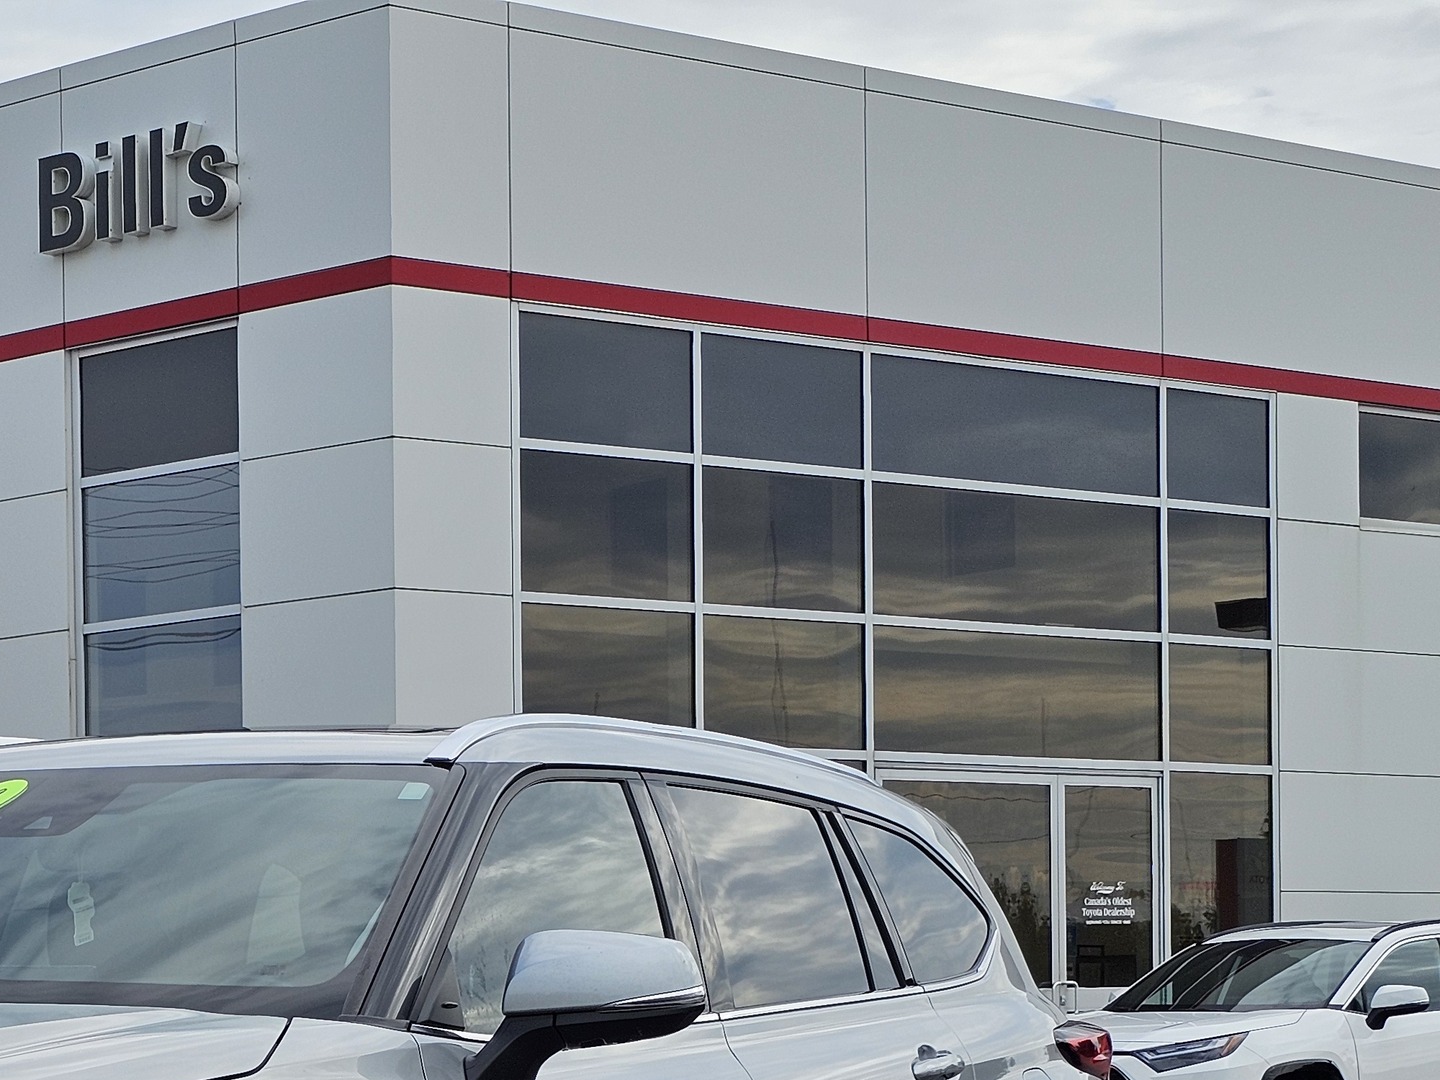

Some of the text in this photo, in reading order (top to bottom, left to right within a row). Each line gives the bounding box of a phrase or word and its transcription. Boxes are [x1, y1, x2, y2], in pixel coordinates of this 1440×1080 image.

[38, 121, 232, 254] Bill's
[1084, 897, 1132, 906] Canada's Oldest
[1081, 907, 1136, 919] Toyota Dealership
